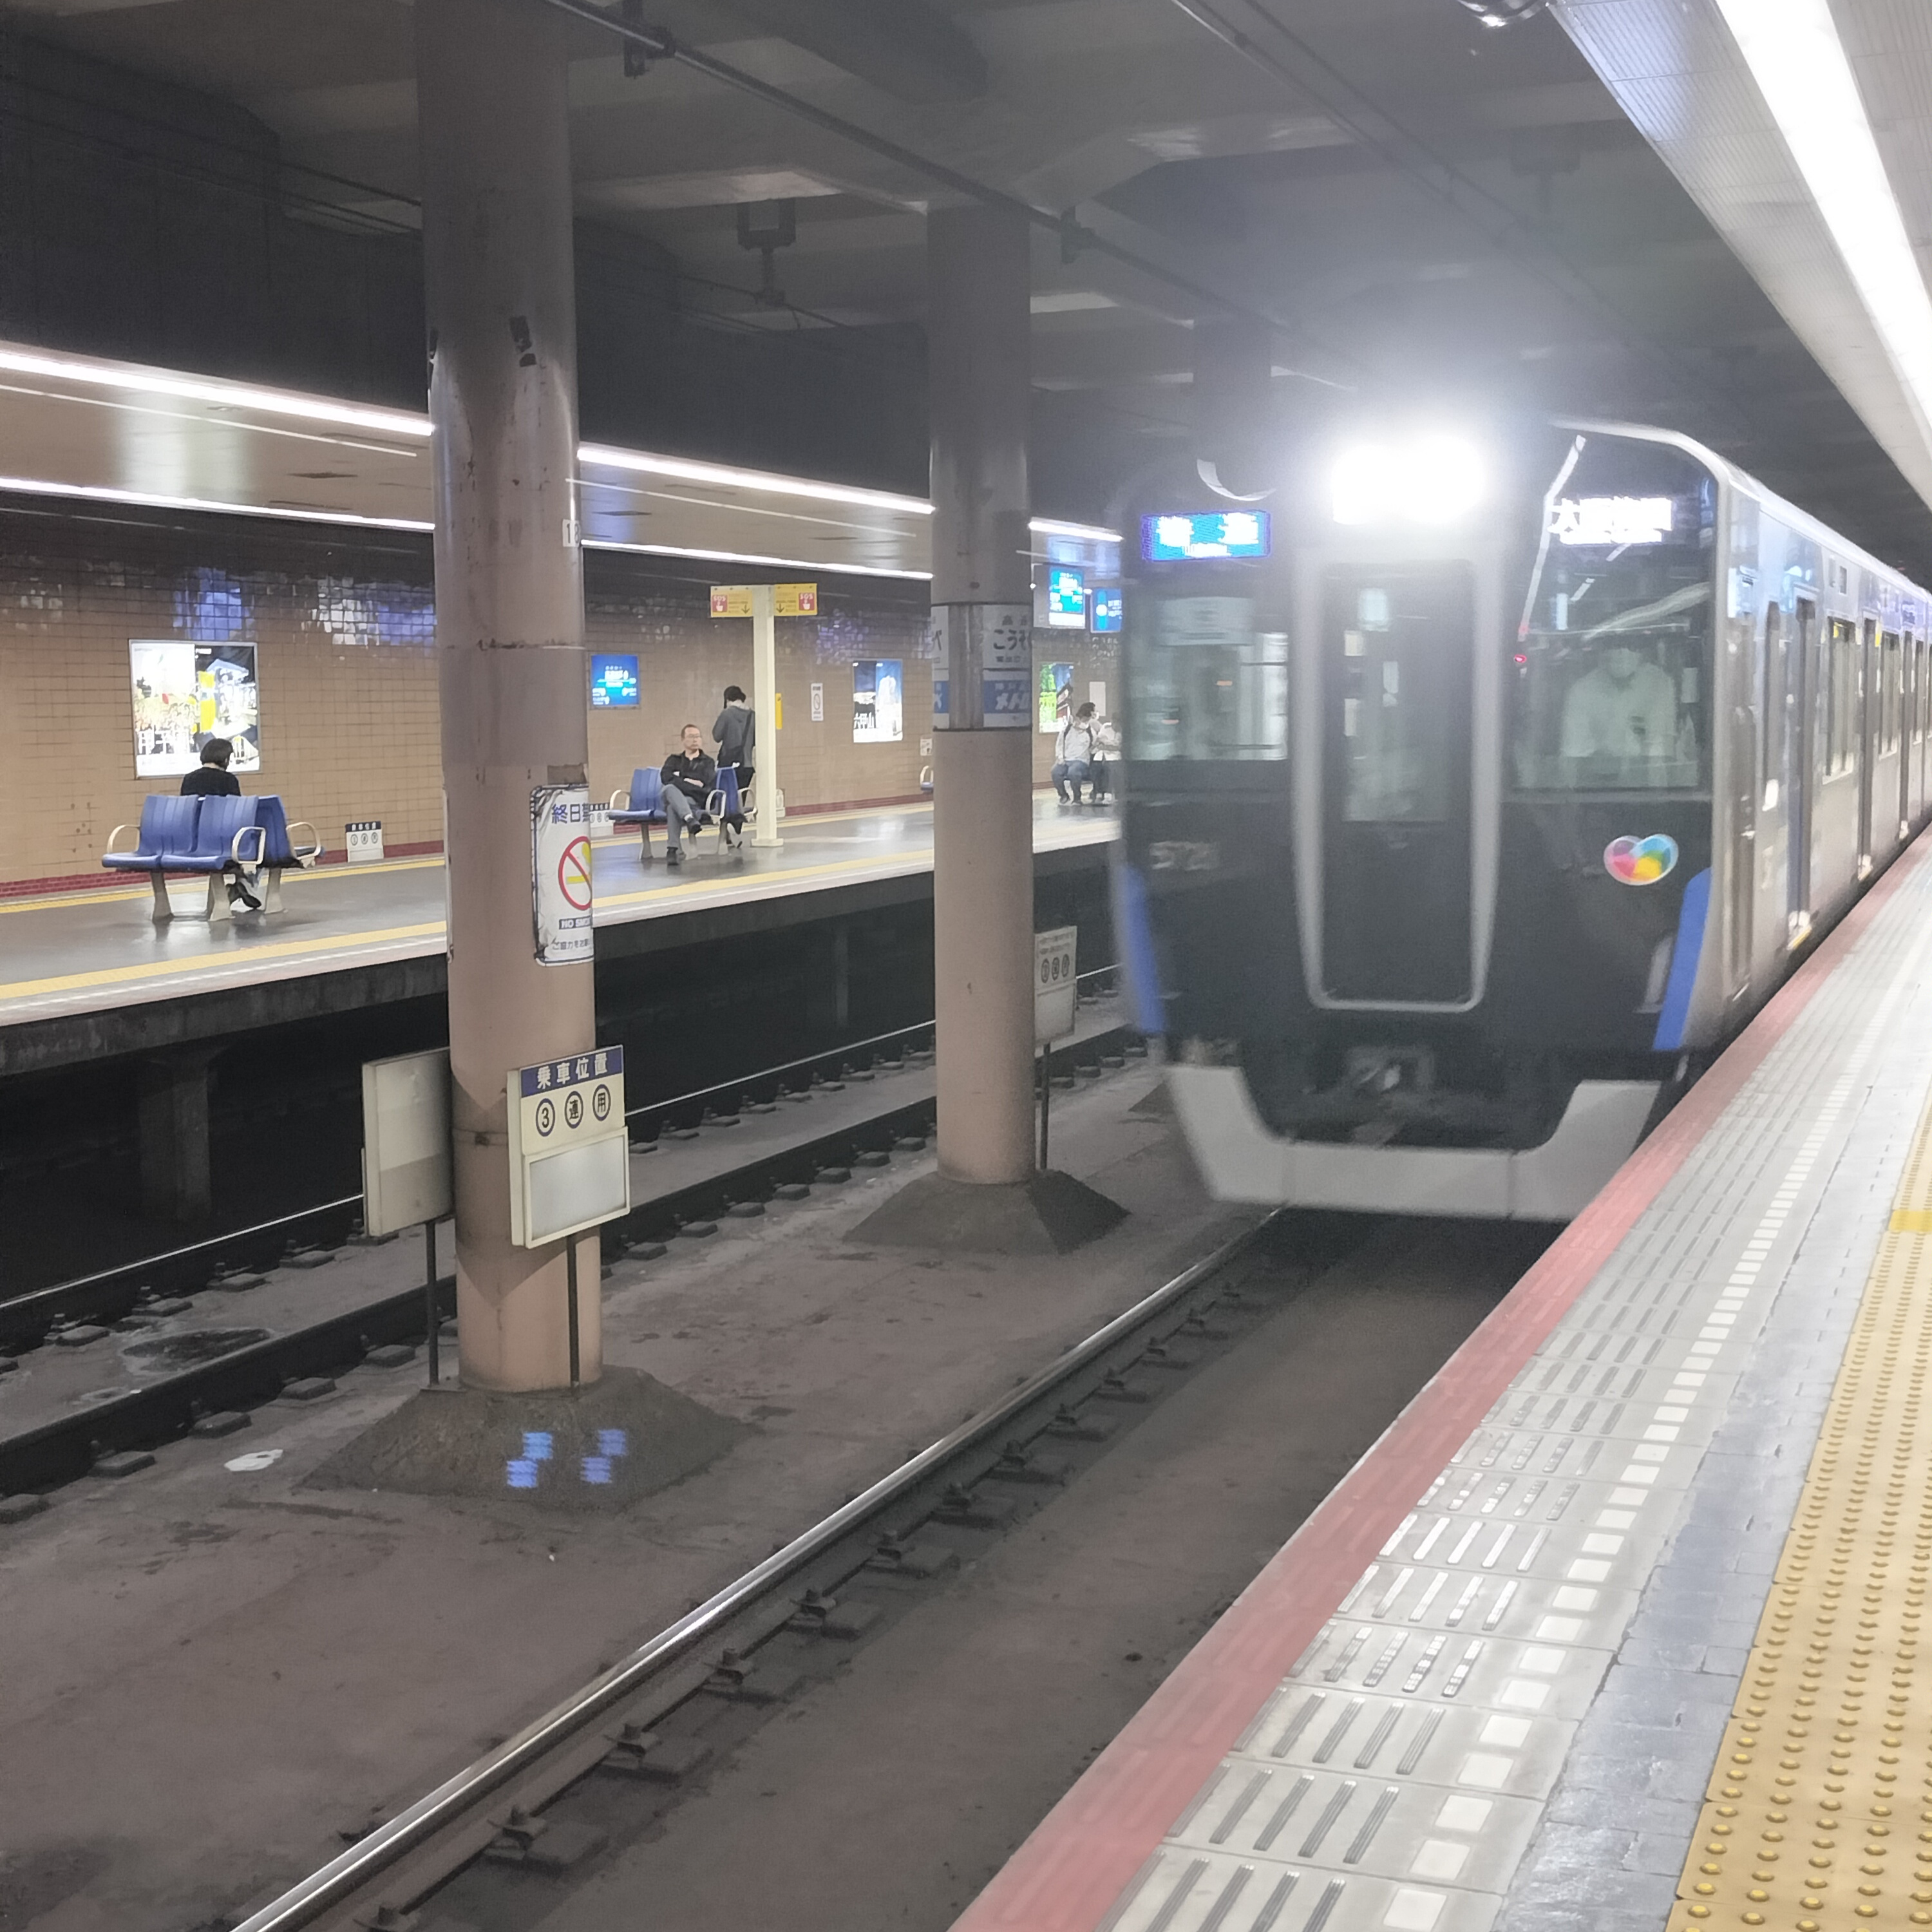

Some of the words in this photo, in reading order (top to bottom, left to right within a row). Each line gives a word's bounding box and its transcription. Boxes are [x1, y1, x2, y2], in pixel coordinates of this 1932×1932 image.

[561, 919, 574, 929] NO
[537, 1052, 607, 1089] 乗車位置
